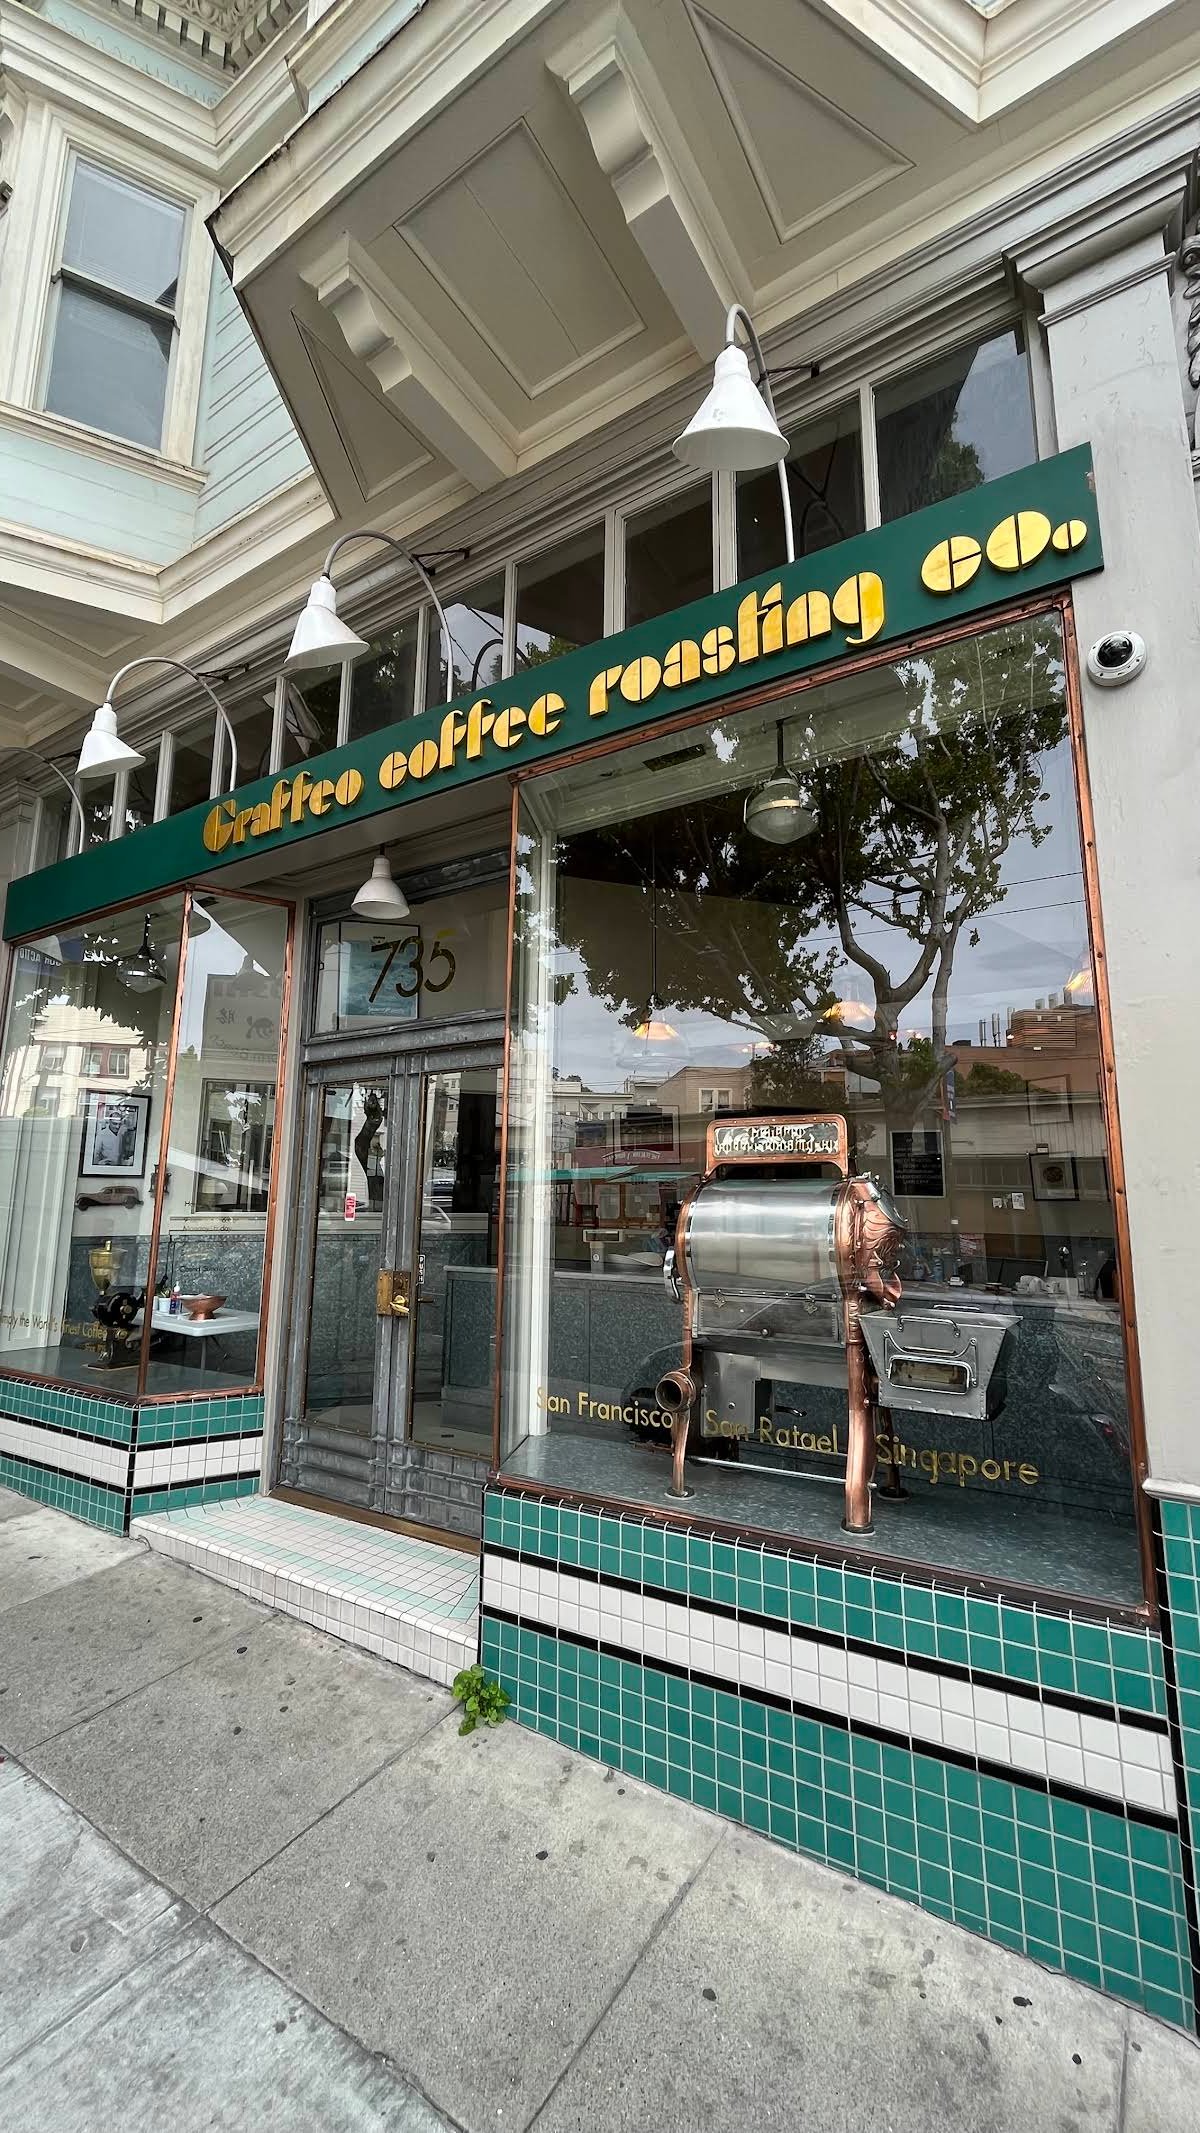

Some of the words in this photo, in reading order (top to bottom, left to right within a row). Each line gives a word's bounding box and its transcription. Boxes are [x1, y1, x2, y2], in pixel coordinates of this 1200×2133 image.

[203, 768, 364, 852] Graffeo
[378, 692, 566, 789] coffee
[588, 571, 886, 717] roasting
[368, 935, 456, 1003] 735
[536, 1386, 570, 1415] San
[578, 1391, 674, 1429] Francisco
[705, 1409, 749, 1442] San
[875, 1433, 1040, 1488] Singapore
